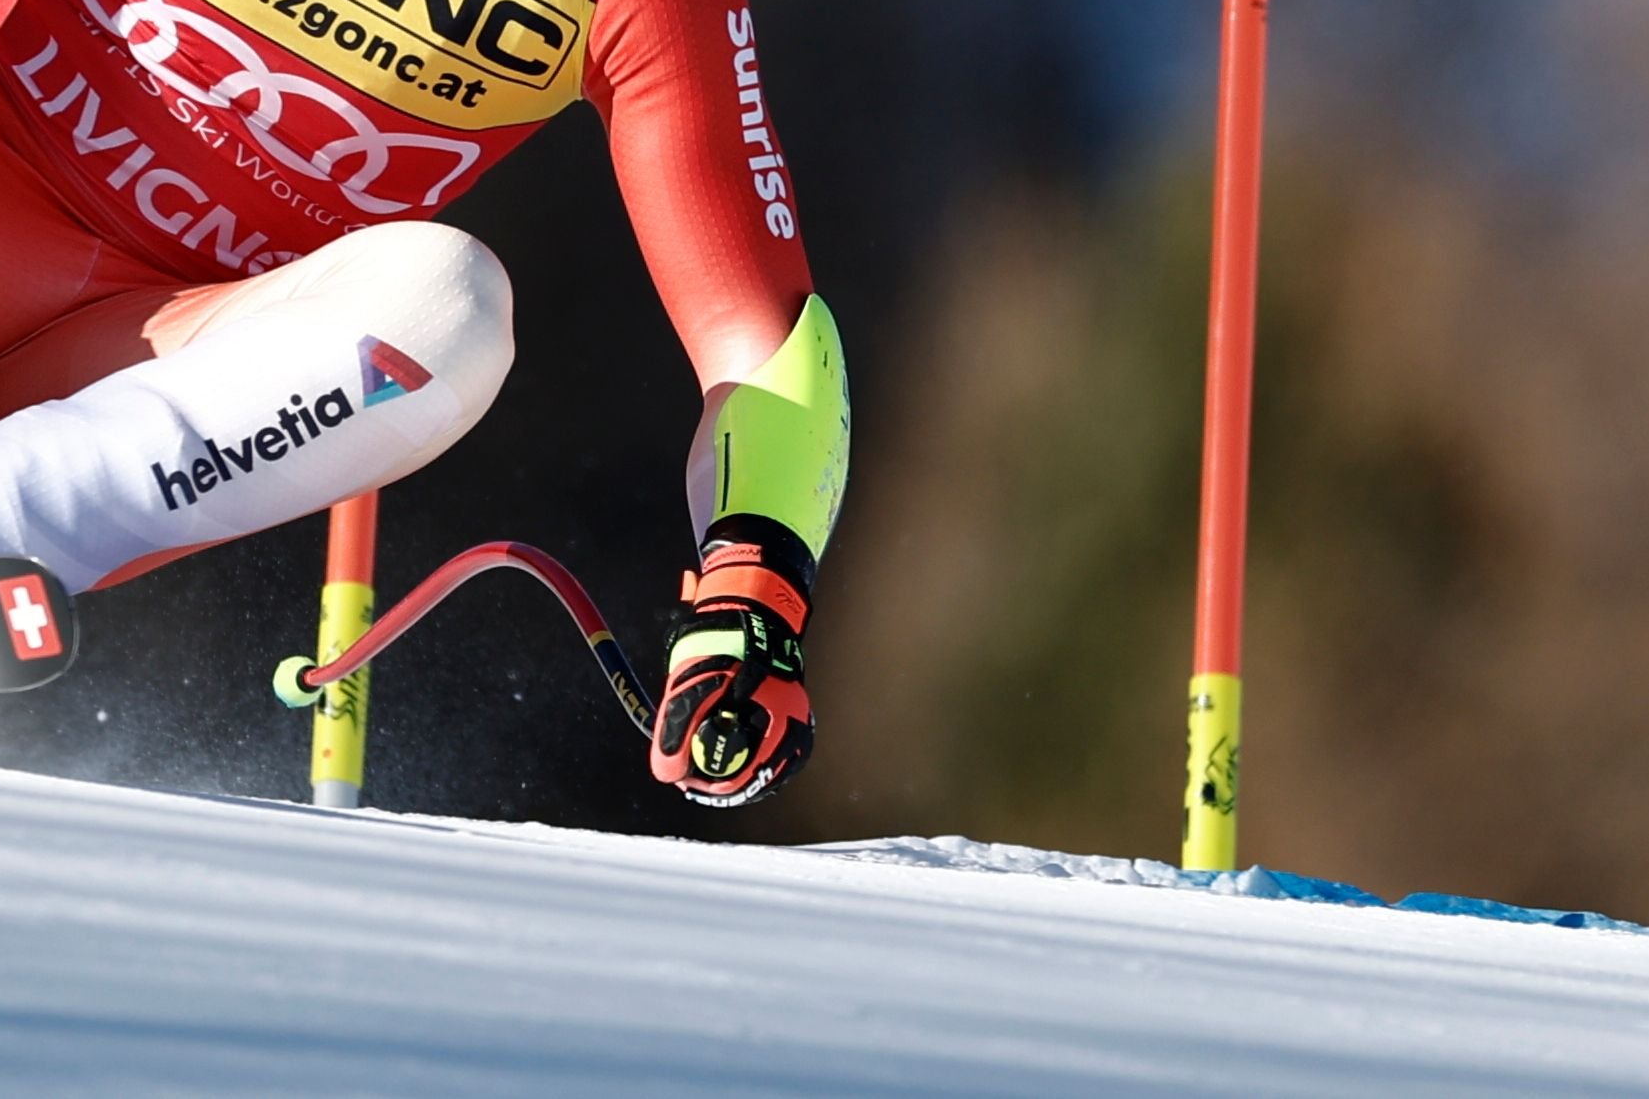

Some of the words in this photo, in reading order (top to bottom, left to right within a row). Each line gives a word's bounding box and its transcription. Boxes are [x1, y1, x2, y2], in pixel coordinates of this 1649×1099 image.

[168, 96, 229, 149] Ski
[727, 6, 796, 240] sunrise
[151, 387, 355, 511] helvetia
[749, 613, 768, 652] LEKI
[710, 734, 728, 772] LEKI
